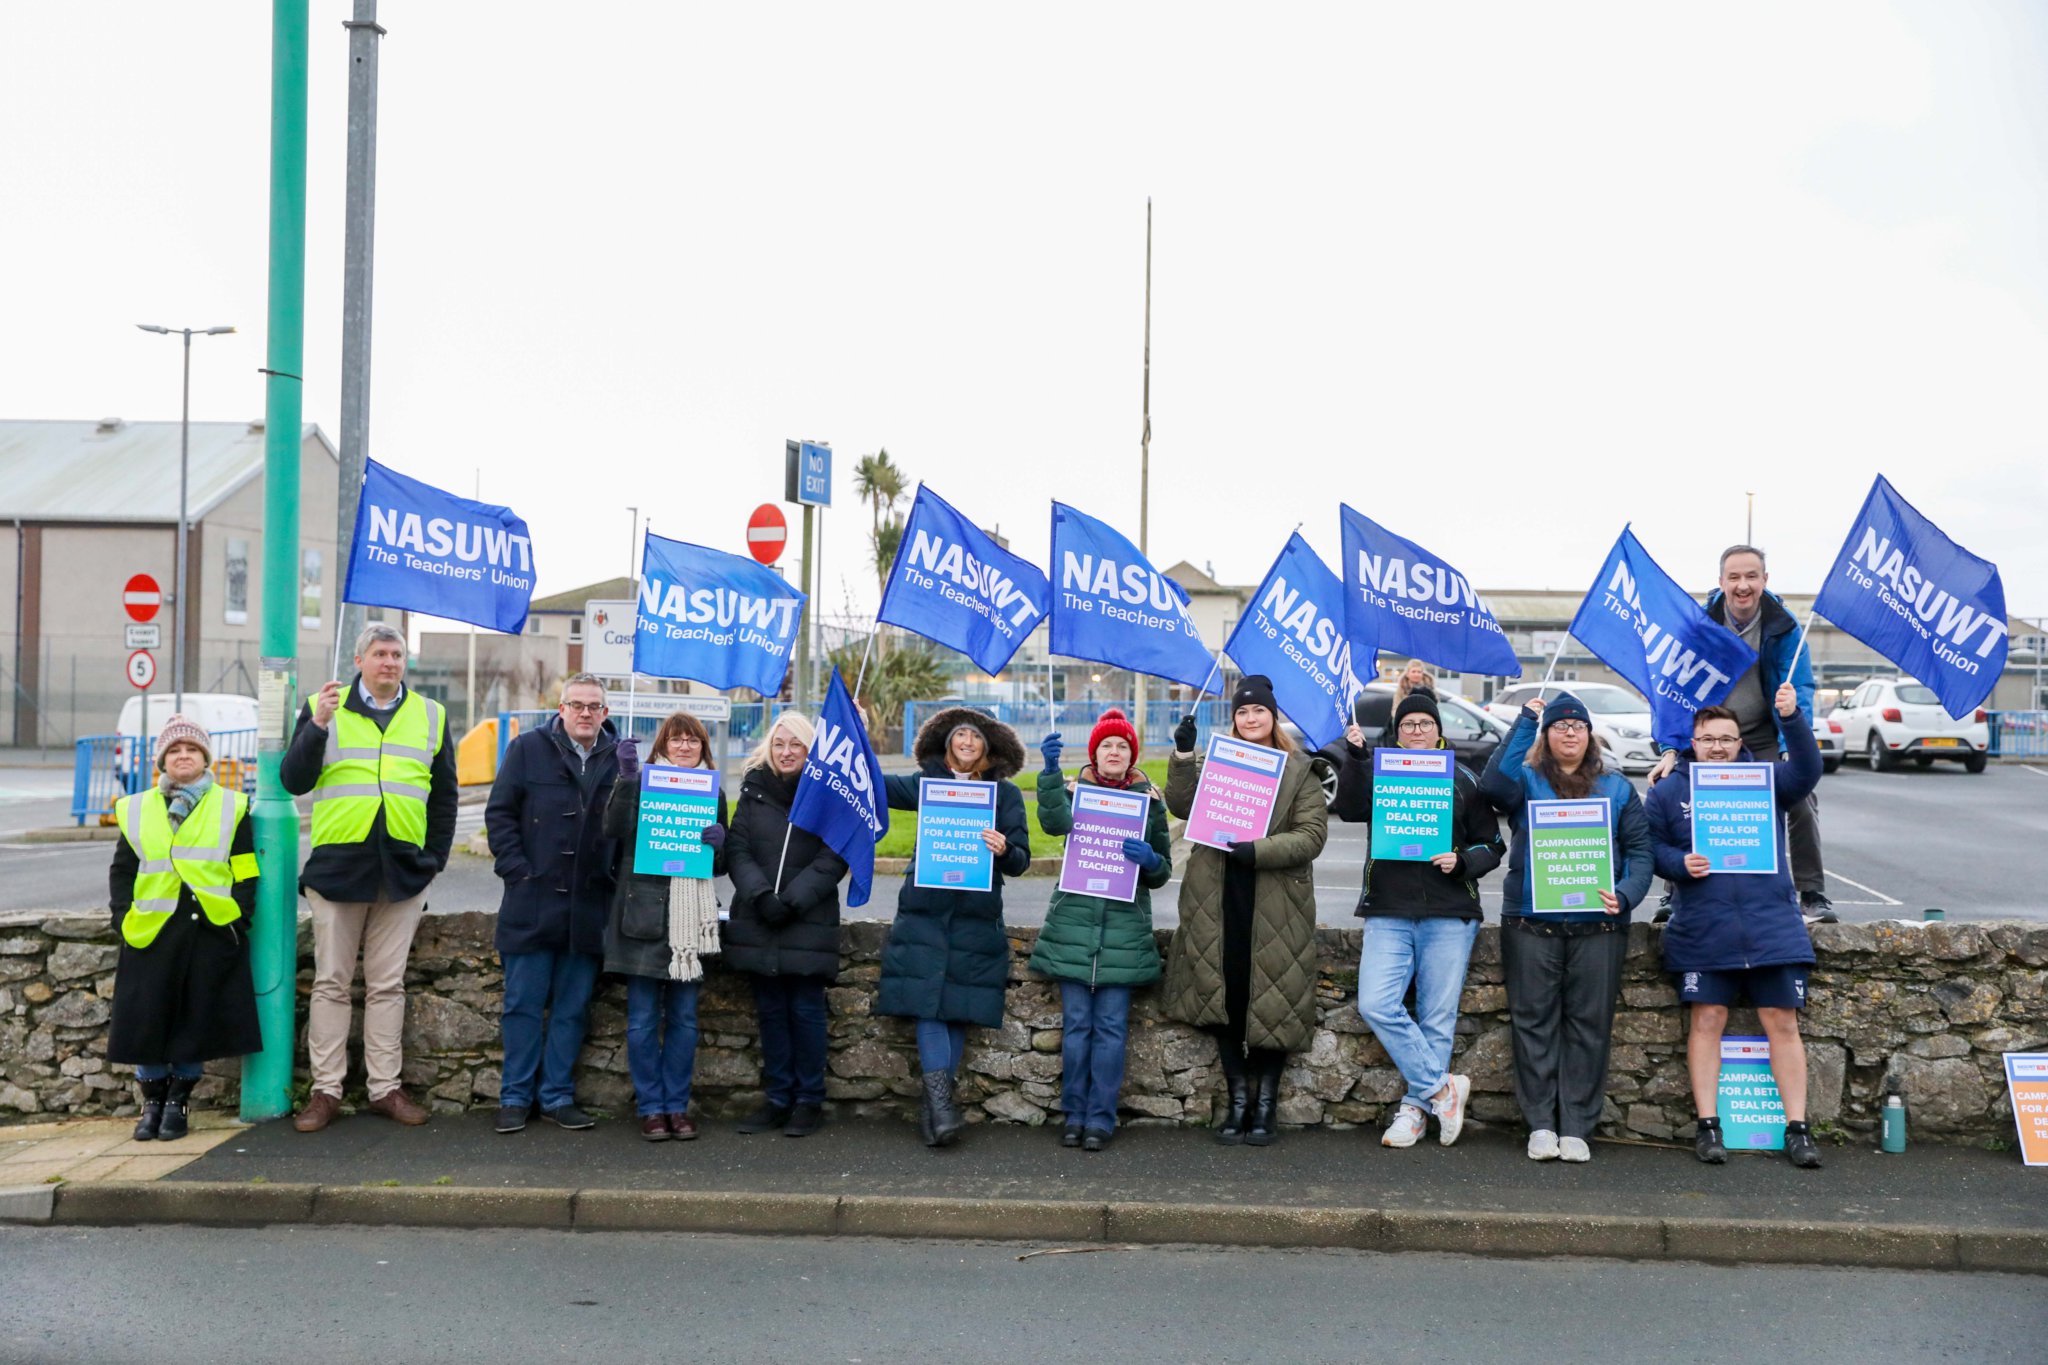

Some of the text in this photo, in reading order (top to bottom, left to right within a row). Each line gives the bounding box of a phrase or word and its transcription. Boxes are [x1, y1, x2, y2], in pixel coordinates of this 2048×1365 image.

[809, 455, 824, 473] NO
[806, 475, 825, 495] EXIT
[368, 505, 530, 572] NASUWT
[366, 545, 529, 590] The Teachers' Union
[907, 529, 1040, 628] NASUWT
[1852, 526, 2008, 659] NASUWT
[639, 574, 799, 639] NASUWT
[904, 567, 934, 590] The
[990, 610, 1014, 639] Union
[1360, 588, 1386, 609] The
[1388, 599, 1466, 625] Teachers'
[1062, 592, 1093, 612] The
[1098, 599, 1180, 632] Teachers'
[1846, 561, 1873, 589] The
[1932, 638, 1979, 676] Union
[664, 623, 737, 646] Teachers'
[739, 629, 785, 657] Union
[1604, 592, 1698, 714] The Union
[137, 661, 145, 676] 5
[1253, 609, 1279, 640] The
[1334, 692, 1348, 730] Union
[632, 701, 653, 709] LEASE
[653, 702, 678, 710] REPORT
[688, 704, 723, 712] RECEPTION
[1205, 771, 1273, 796] CAMPAIGNING
[1374, 785, 1451, 796] CAMPAIGNING
[1204, 784, 1268, 808] FOR A BETTER
[640, 800, 716, 815] CAMPAIGNING
[1210, 798, 1256, 817] DEAL FOR
[1376, 798, 1449, 810] FOR A BETTER
[1696, 800, 1770, 809] CAMPAIGNING
[641, 813, 713, 827] FOR A BETTER
[923, 816, 991, 828] CAMPAIGNING
[1206, 810, 1253, 830] TEACHERS
[1386, 812, 1438, 822] DEAL FOR
[1698, 813, 1719, 822] FOR
[1721, 813, 1729, 822] A
[1731, 813, 1769, 822] BETTER
[651, 827, 701, 840] DEAL FOR
[924, 828, 983, 840] FOR A BETTE
[1073, 822, 1140, 839] CAMPAIGNING
[1384, 825, 1439, 836] TEACHERS
[1709, 826, 1759, 834] DEAL FOR
[648, 840, 702, 853] TEACHERS
[933, 841, 978, 851] DEAL FOR
[1073, 834, 1124, 849] FOR A BETT
[1535, 837, 1607, 848] CAMPAIGNING
[1707, 838, 1761, 847] TEACHERS
[931, 853, 979, 864] TEACHERS
[1081, 848, 1125, 862] DEAL FOR
[1537, 851, 1606, 860] FOR A BETTER
[1078, 859, 1125, 874] TEACHERS
[1548, 864, 1596, 873] DEAL FOR
[1547, 876, 1599, 886] TEACHERS
[1719, 1087, 1780, 1096] FOR A BETT
[1731, 1101, 1784, 1110] DEAL FOR
[2021, 1104, 2043, 1113] FOR
[1730, 1114, 1787, 1124] TEACHERS
